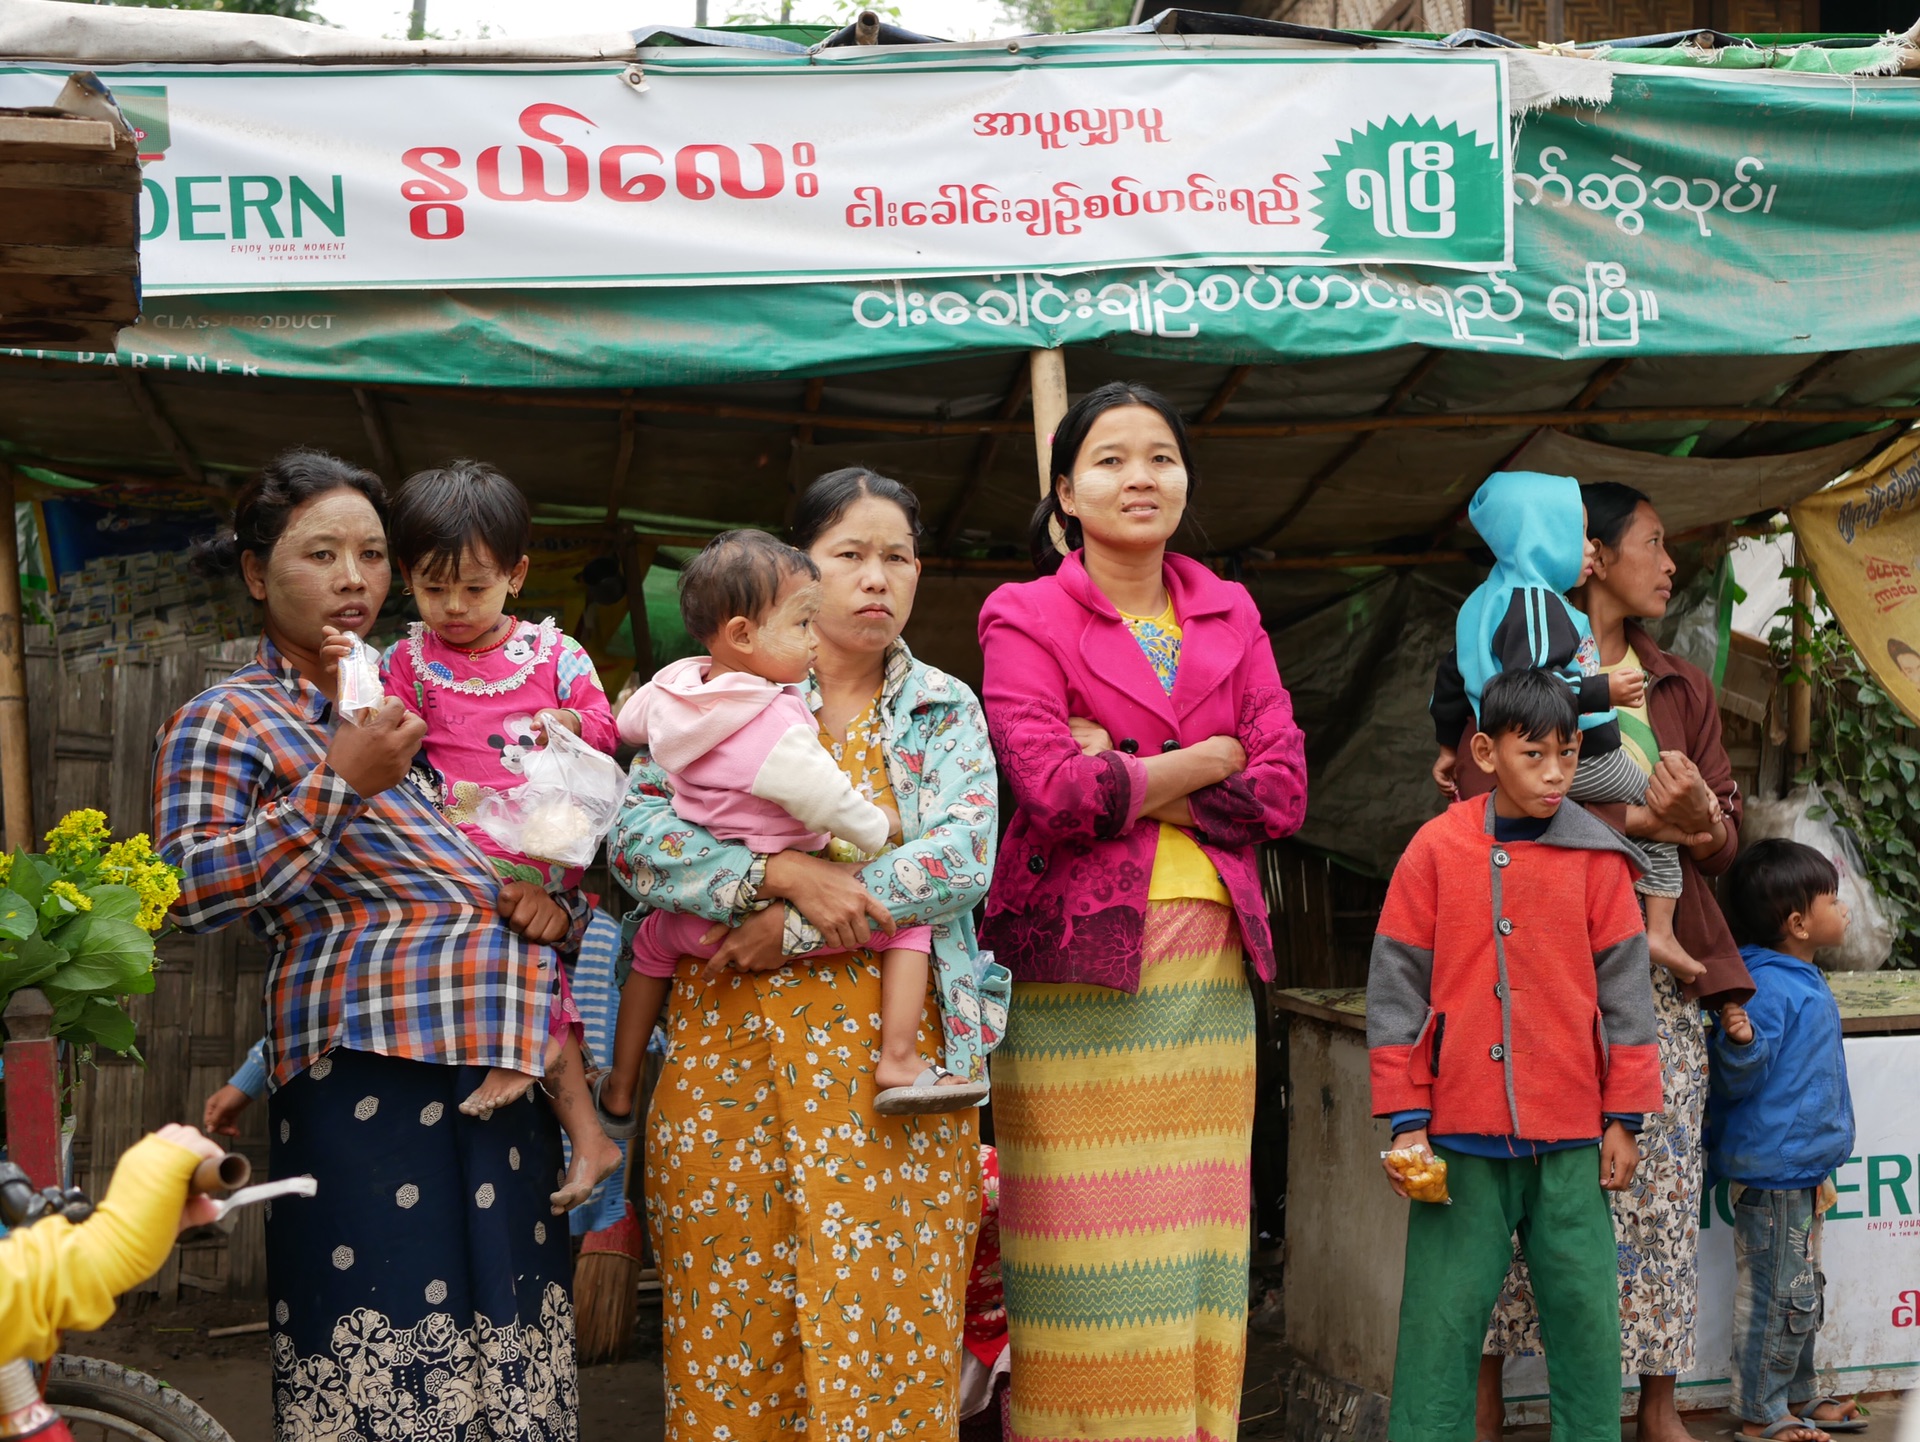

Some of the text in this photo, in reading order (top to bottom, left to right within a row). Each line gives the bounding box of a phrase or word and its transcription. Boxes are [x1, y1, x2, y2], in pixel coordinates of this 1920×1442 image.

[400, 102, 819, 240] နွယ်လေး
[1345, 140, 1457, 240] ရပြီ
[231, 242, 346, 254] ENJOY YOUR MOMENT
[153, 314, 222, 329] CLASS
[229, 314, 337, 329] PRODUCT
[1867, 1221, 1893, 1231] ENJOY
